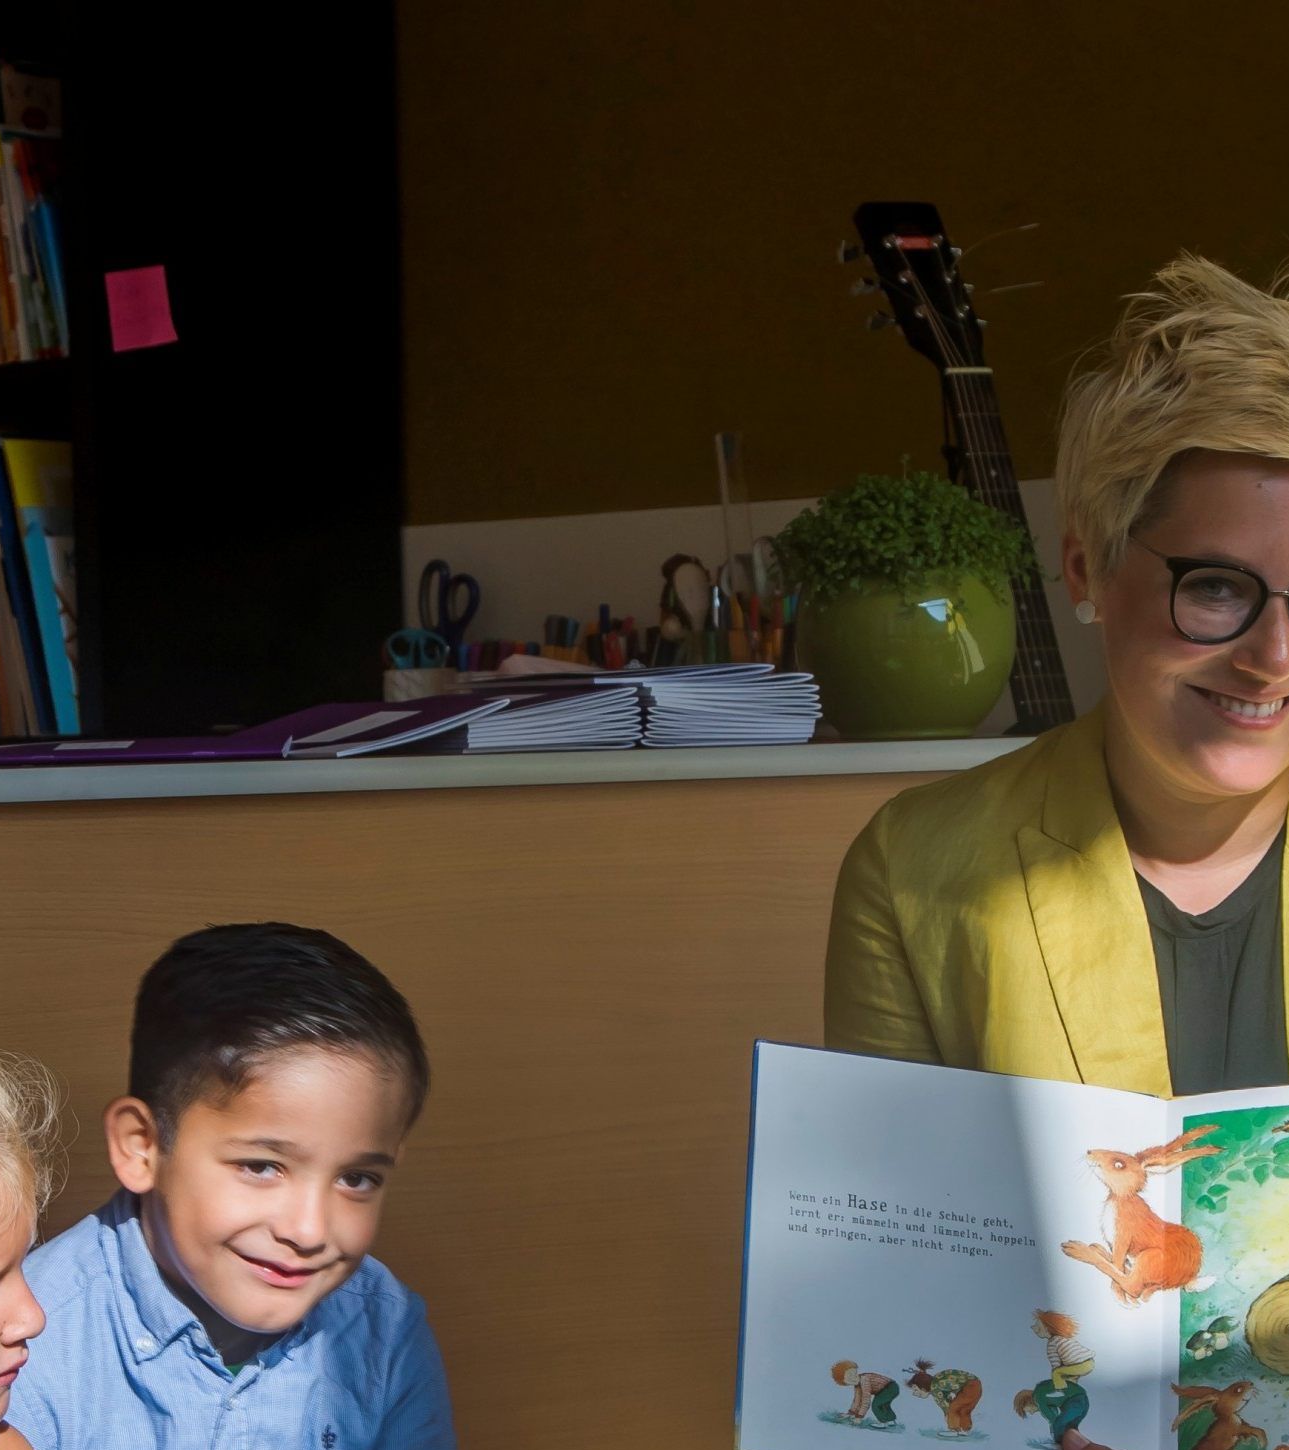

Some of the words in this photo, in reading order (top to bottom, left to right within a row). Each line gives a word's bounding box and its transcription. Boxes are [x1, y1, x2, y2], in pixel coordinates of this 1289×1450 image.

[822, 1196, 841, 1206] ein
[847, 1193, 888, 1212] Hase
[895, 1204, 908, 1215] in
[913, 1207, 932, 1218] die
[938, 1210, 977, 1224] Schule
[788, 1223, 808, 1233] und
[878, 1234, 906, 1246] aber
[911, 1238, 943, 1251] nicht
[789, 1206, 821, 1220] lernt
[851, 1215, 899, 1230] mümmeln
[905, 1223, 925, 1233] und
[990, 1231, 1036, 1247] hoppeln
